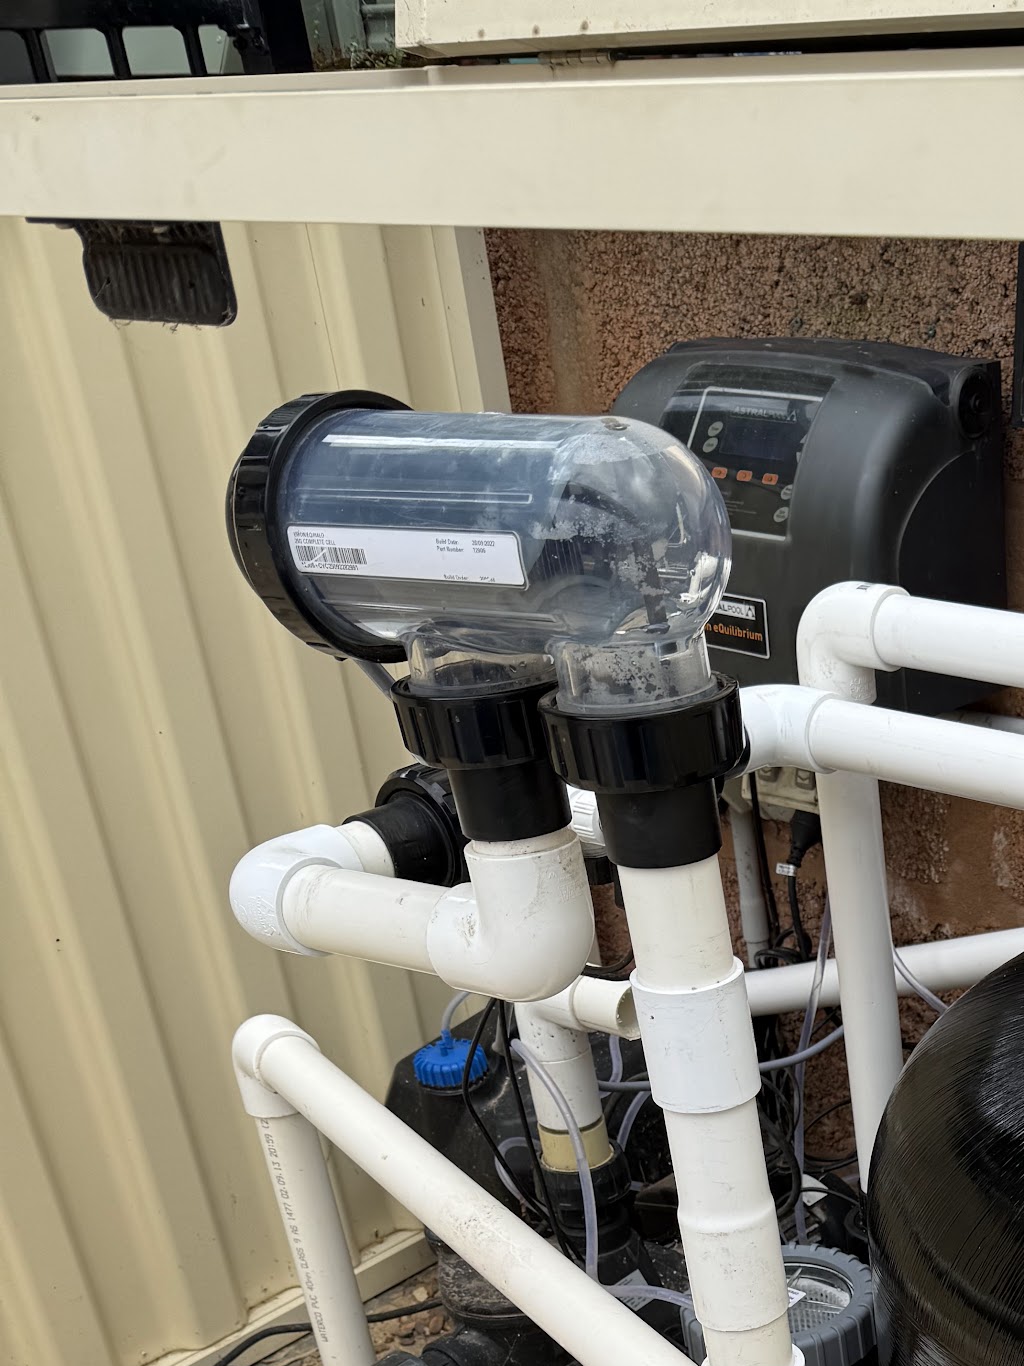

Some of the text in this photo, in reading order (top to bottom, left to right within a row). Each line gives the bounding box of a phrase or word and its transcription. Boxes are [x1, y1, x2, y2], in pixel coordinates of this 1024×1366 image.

[713, 623, 763, 642] eQuilibrium
[264, 1133, 278, 1158] 20:59
[283, 1203, 296, 1221] 1477
[289, 1225, 300, 1235] AS
[296, 1247, 309, 1269] CLASS
[309, 1294, 320, 1309] PVC
[314, 1312, 328, 1342] WATERCO
